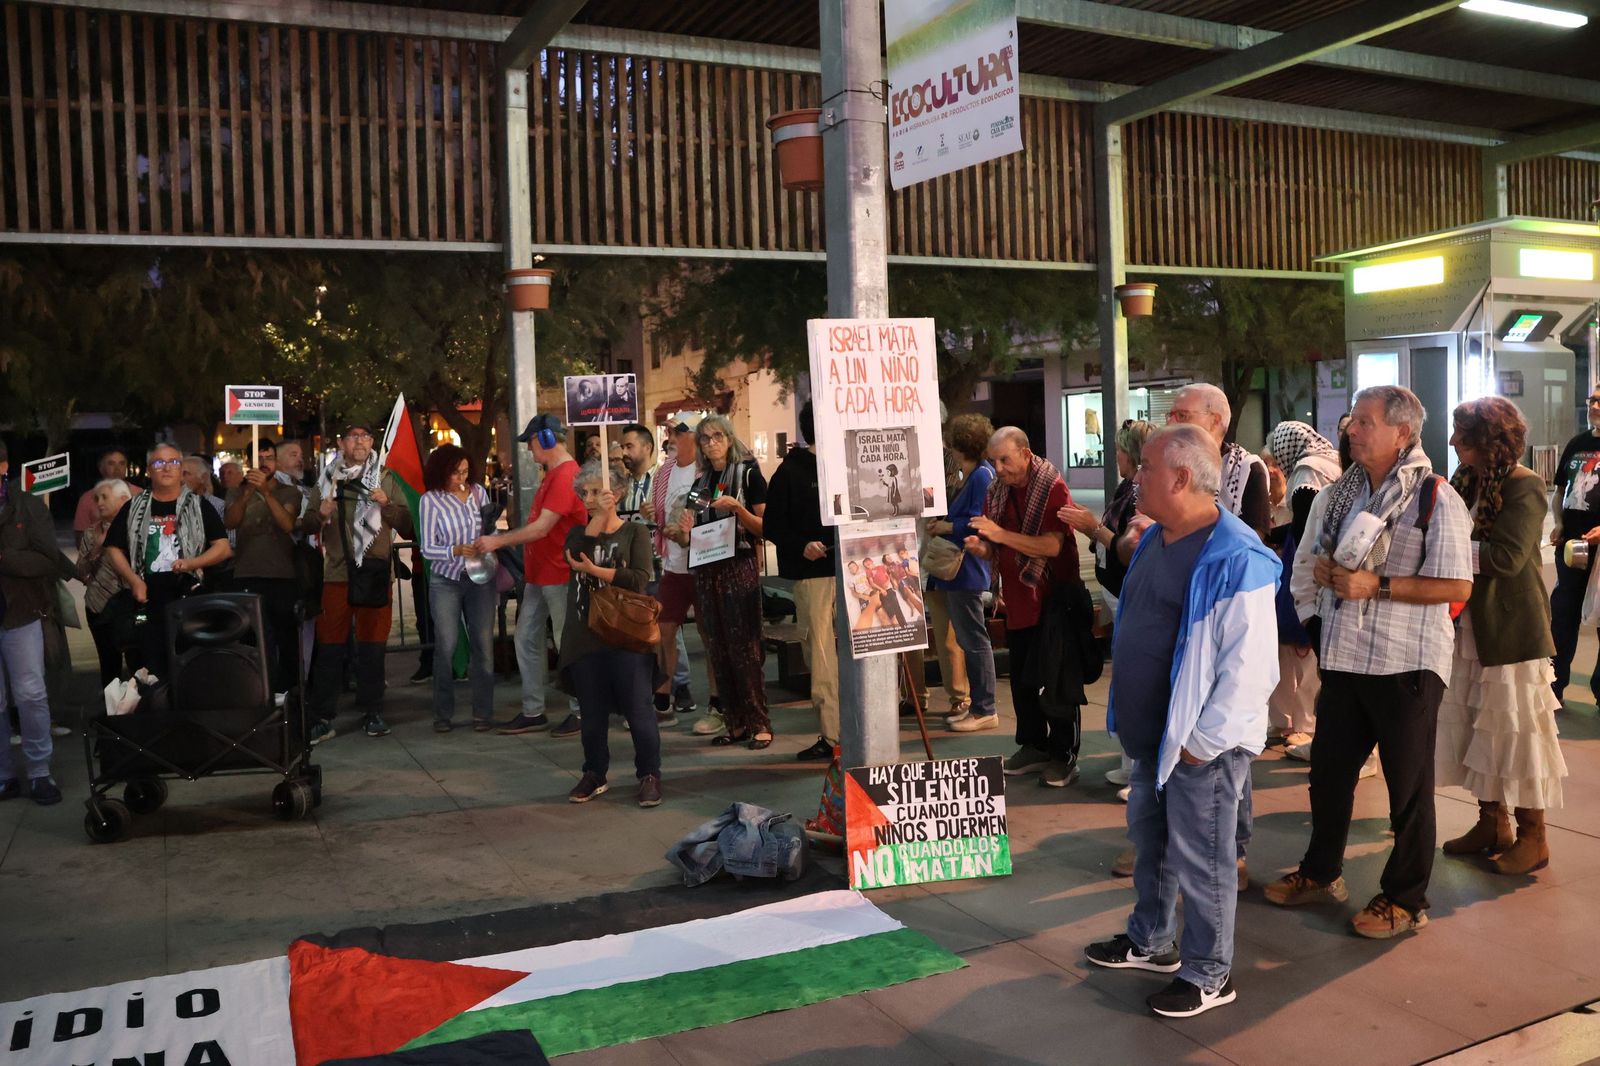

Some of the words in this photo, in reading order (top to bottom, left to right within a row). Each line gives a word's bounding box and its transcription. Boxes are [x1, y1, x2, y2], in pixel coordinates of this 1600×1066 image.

[892, 52, 1013, 127] ECOCULTURA
[829, 325, 874, 353] ISRAEL
[878, 325, 918, 351] MATA
[829, 358, 841, 384] A
[845, 356, 867, 384] UN
[880, 351, 919, 383] NIÑO
[244, 390, 266, 398] STOP
[835, 386, 878, 414] CADA
[884, 385, 924, 413] HORA
[858, 434, 885, 445] ISRAEL
[886, 433, 906, 442] MATA
[862, 445, 869, 454] A
[869, 444, 881, 453] UN
[38, 461, 57, 471] STOP
[860, 454, 882, 464] CADA
[883, 452, 907, 462] HORA.
[869, 765, 897, 786] HAY
[900, 763, 926, 782] QUE
[933, 759, 979, 779] HACER
[887, 775, 989, 805] SILENCIO
[896, 802, 960, 821] CUANDO
[966, 797, 995, 816] LOS
[873, 820, 927, 848] NIÑOS
[936, 815, 1007, 841] DUERMEN
[969, 836, 1000, 854] LOS
[852, 847, 896, 888] NO
[910, 854, 993, 882] MATAN
